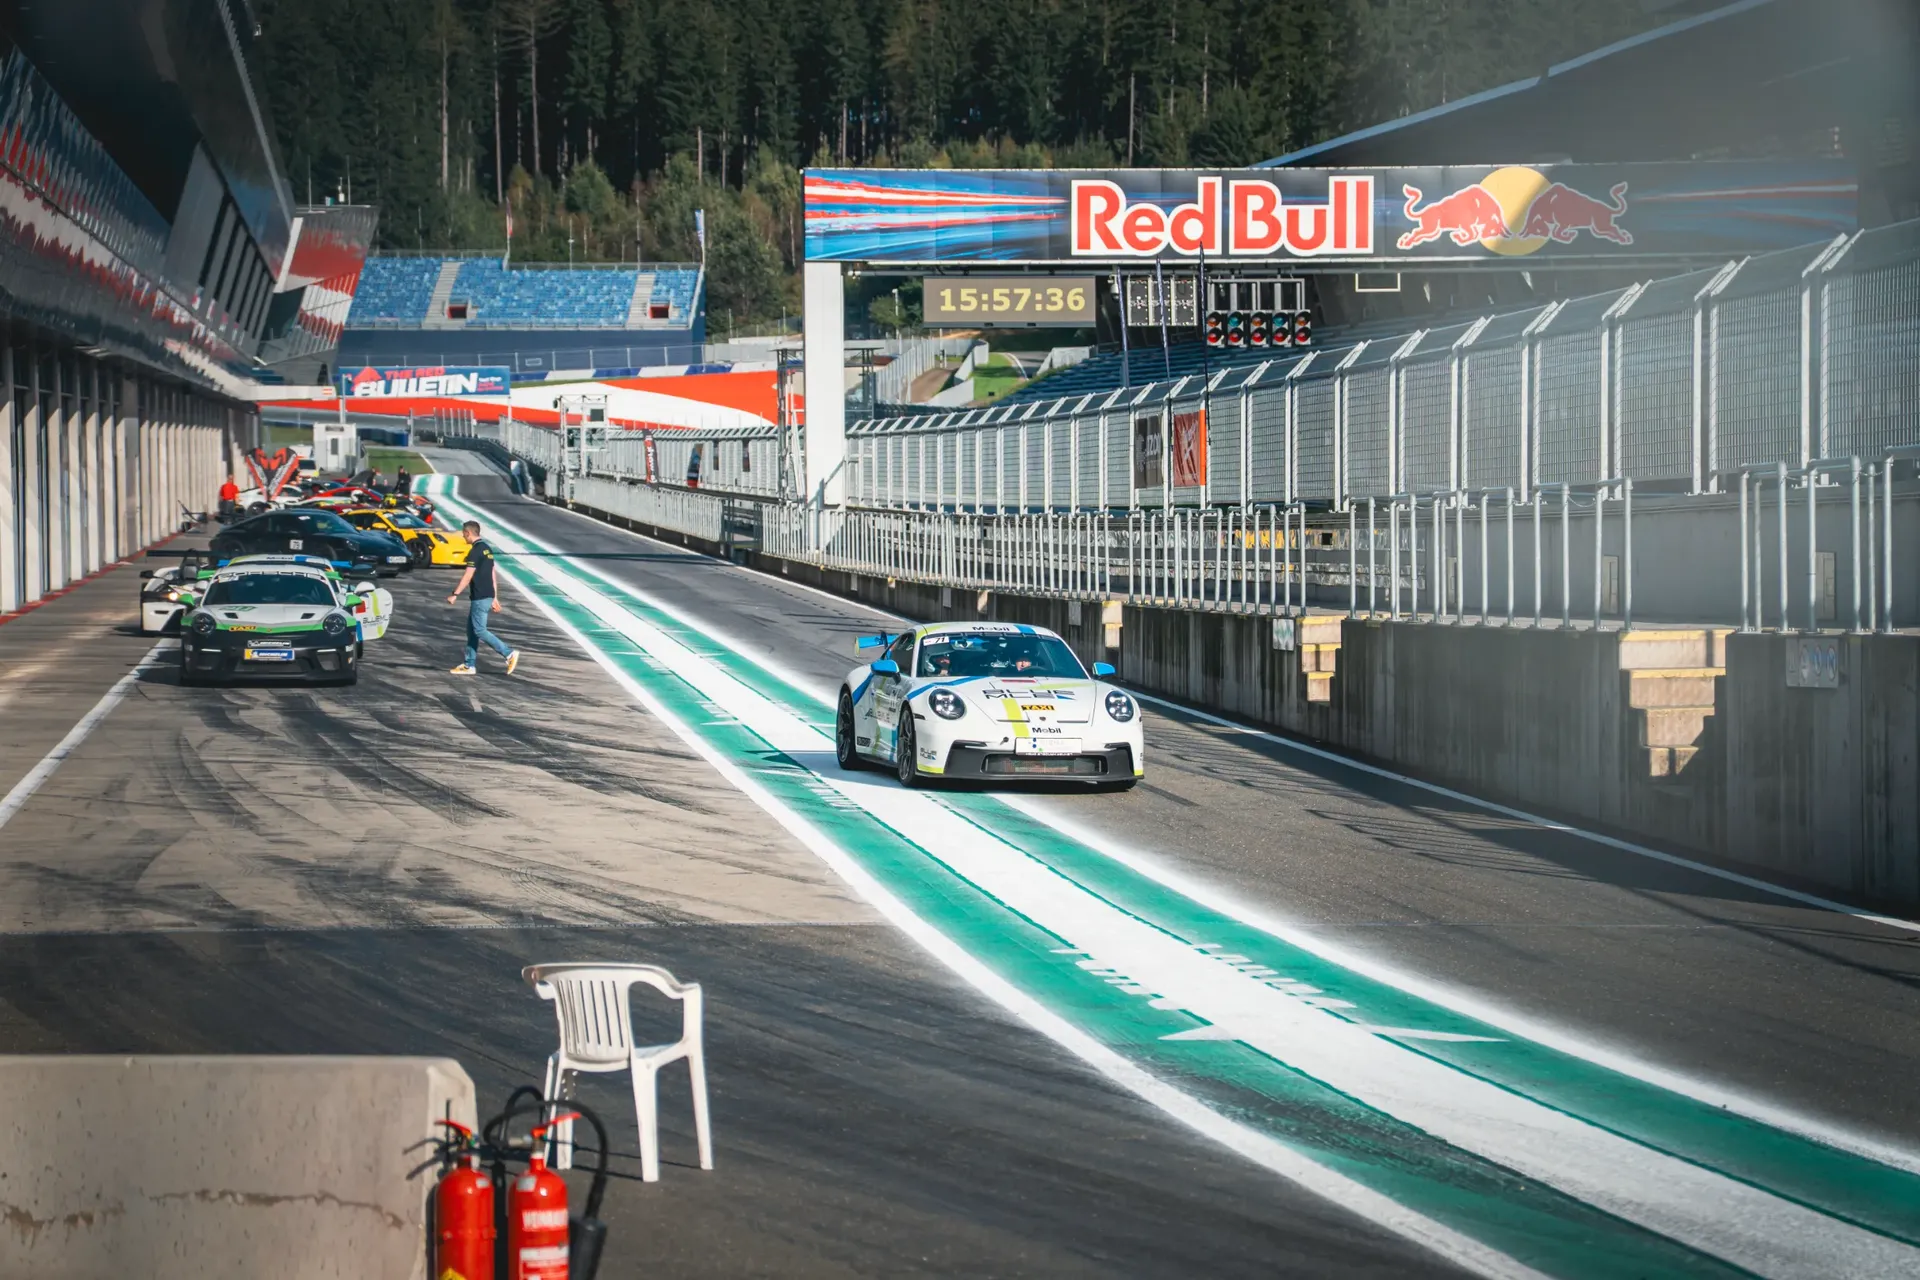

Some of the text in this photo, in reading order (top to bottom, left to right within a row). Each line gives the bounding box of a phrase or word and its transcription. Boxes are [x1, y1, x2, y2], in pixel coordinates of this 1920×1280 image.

[1071, 175, 1375, 257] Red Bull
[940, 287, 1086, 312] 15:57:36
[354, 372, 478, 397] BULLETIN
[385, 367, 445, 380] THE RED
